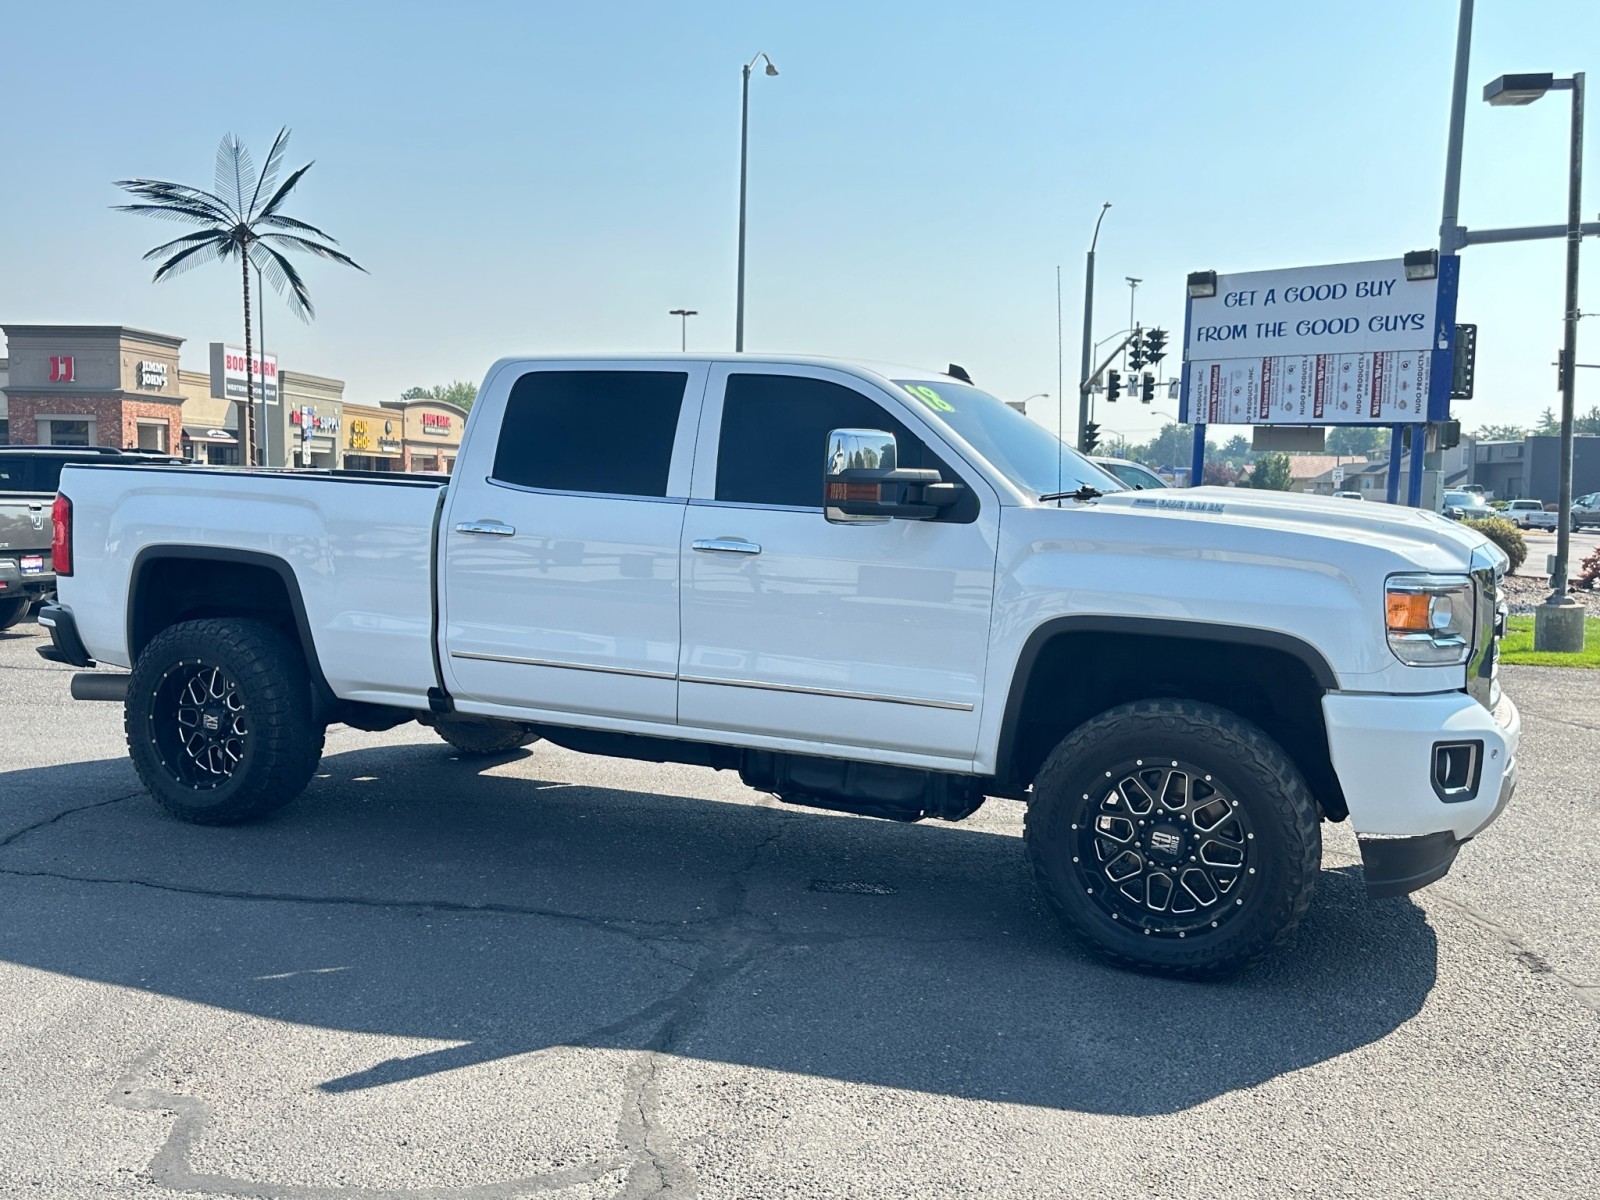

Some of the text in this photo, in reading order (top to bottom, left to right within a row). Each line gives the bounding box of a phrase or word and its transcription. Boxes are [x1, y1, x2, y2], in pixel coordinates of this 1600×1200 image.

[1224, 278, 1397, 308] GET A GOOD BUY
[1196, 313, 1425, 342] FROM THE GOOD GUYS
[142, 361, 168, 374] JIMMY
[226, 355, 248, 372] BOO
[142, 373, 168, 386] JOHN'S
[904, 384, 956, 413] 18
[320, 416, 341, 430] SUPPLY
[354, 420, 368, 433] GUN
[352, 435, 370, 448] SHOP
[1151, 831, 1172, 853] XD
